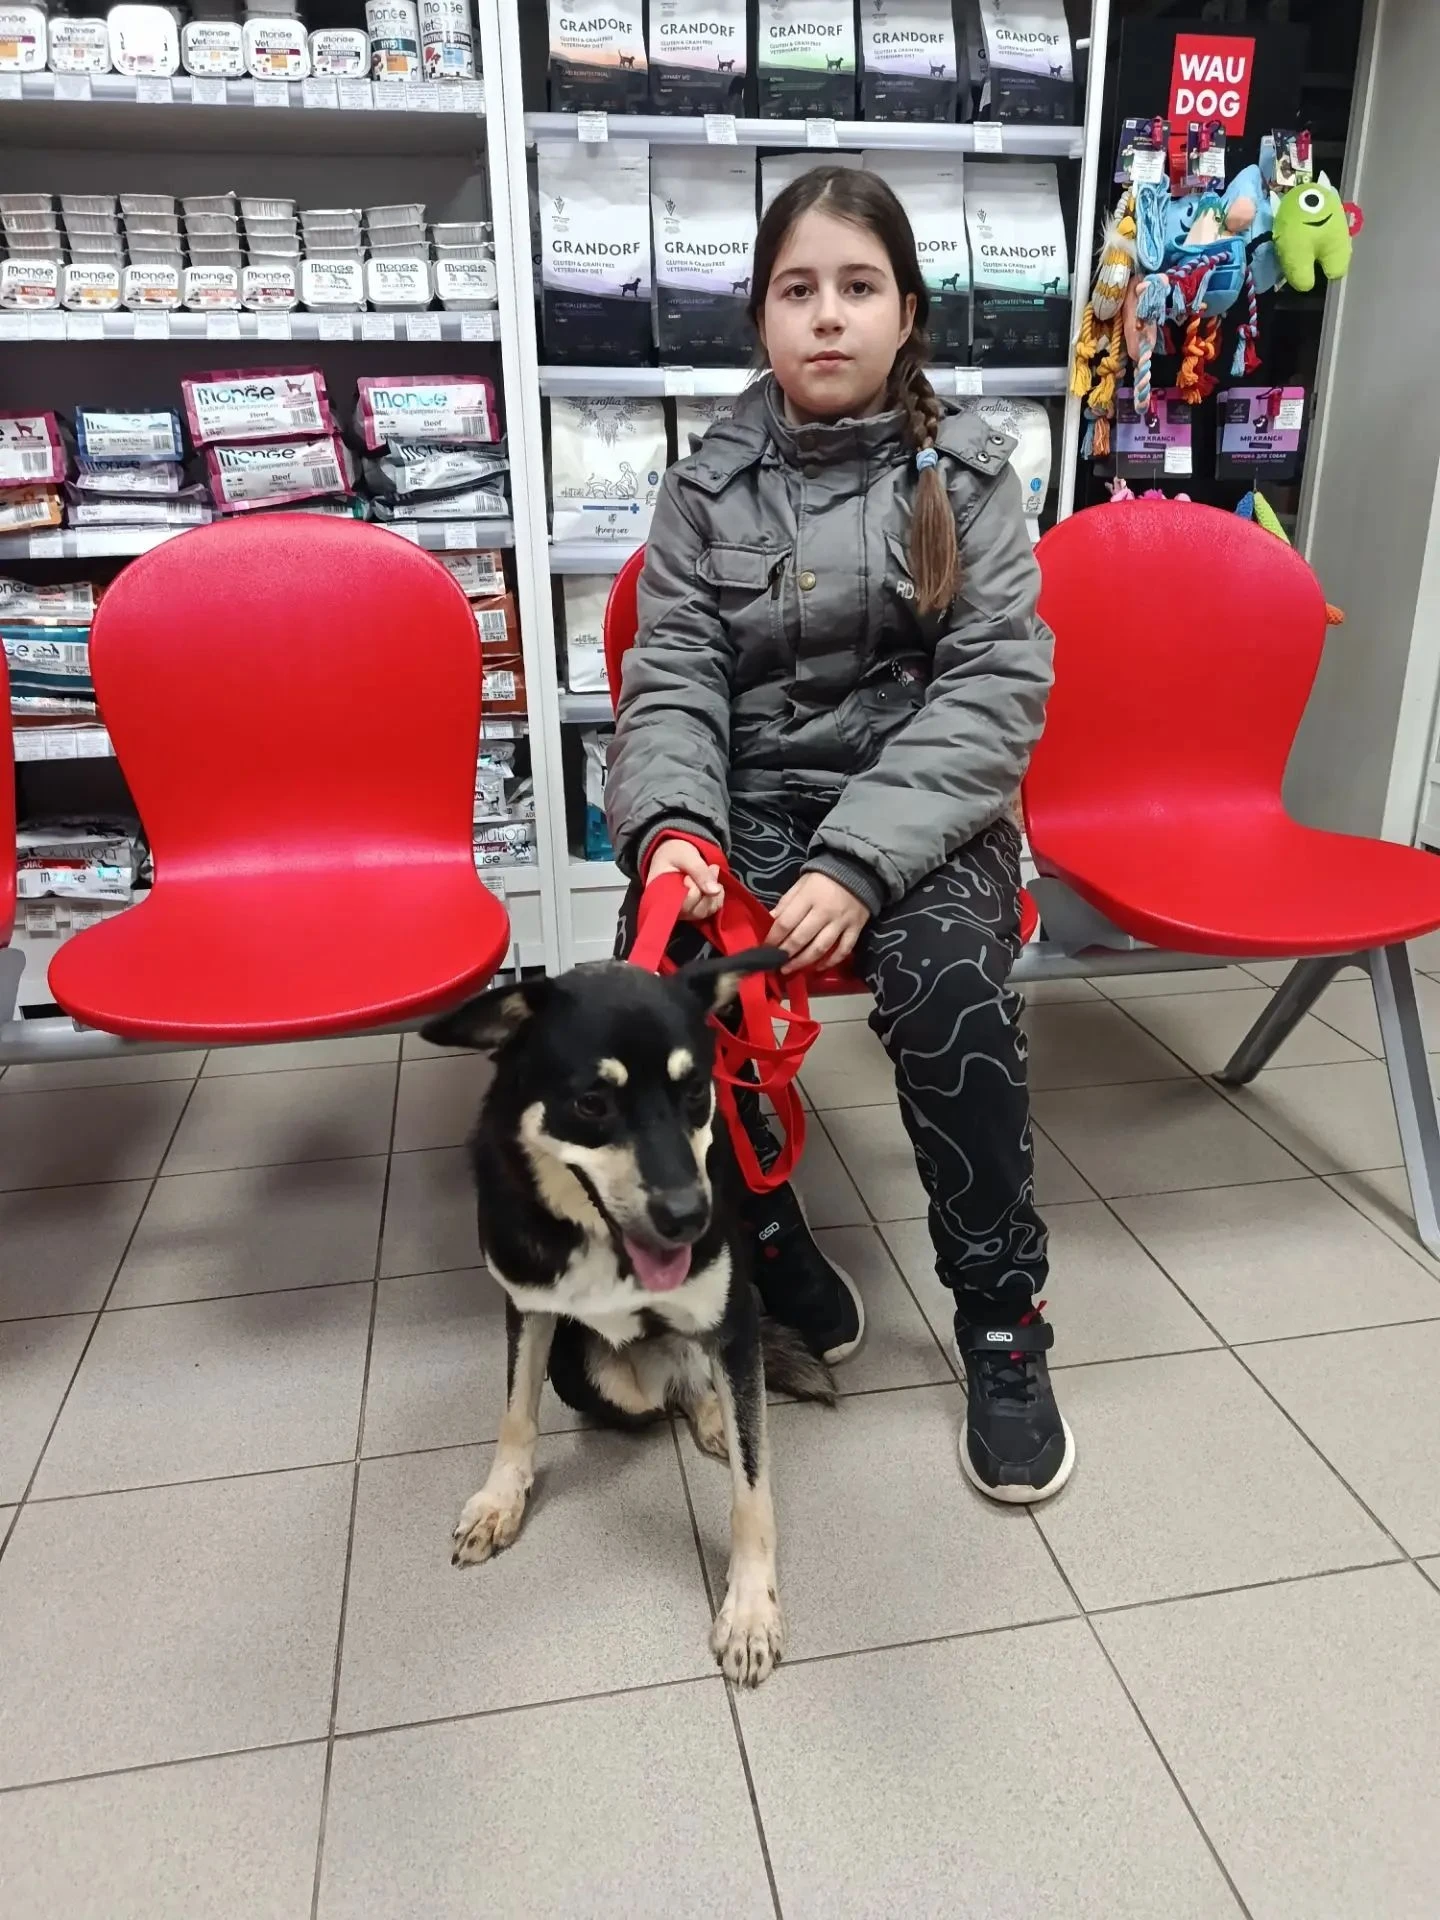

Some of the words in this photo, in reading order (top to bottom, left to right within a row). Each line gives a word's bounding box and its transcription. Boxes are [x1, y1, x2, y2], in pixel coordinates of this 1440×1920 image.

[560, 19, 633, 34] GRANDORF
[660, 23, 735, 37] GRANDORF
[770, 24, 843, 38] GRANDORF
[873, 32, 944, 43] GRANDORF
[996, 29, 1059, 46] GRANDORF
[1180, 54, 1246, 84] WAU
[1175, 89, 1241, 117] DOG
[552, 240, 640, 256] GRANDORF
[664, 242, 750, 256] GRANDORF
[917, 240, 958, 252] DORF
[981, 245, 1057, 258] GRANDORF
[474, 828, 527, 843] olution
[758, 1221, 780, 1241] GSD
[986, 1331, 1014, 1343] GSD
